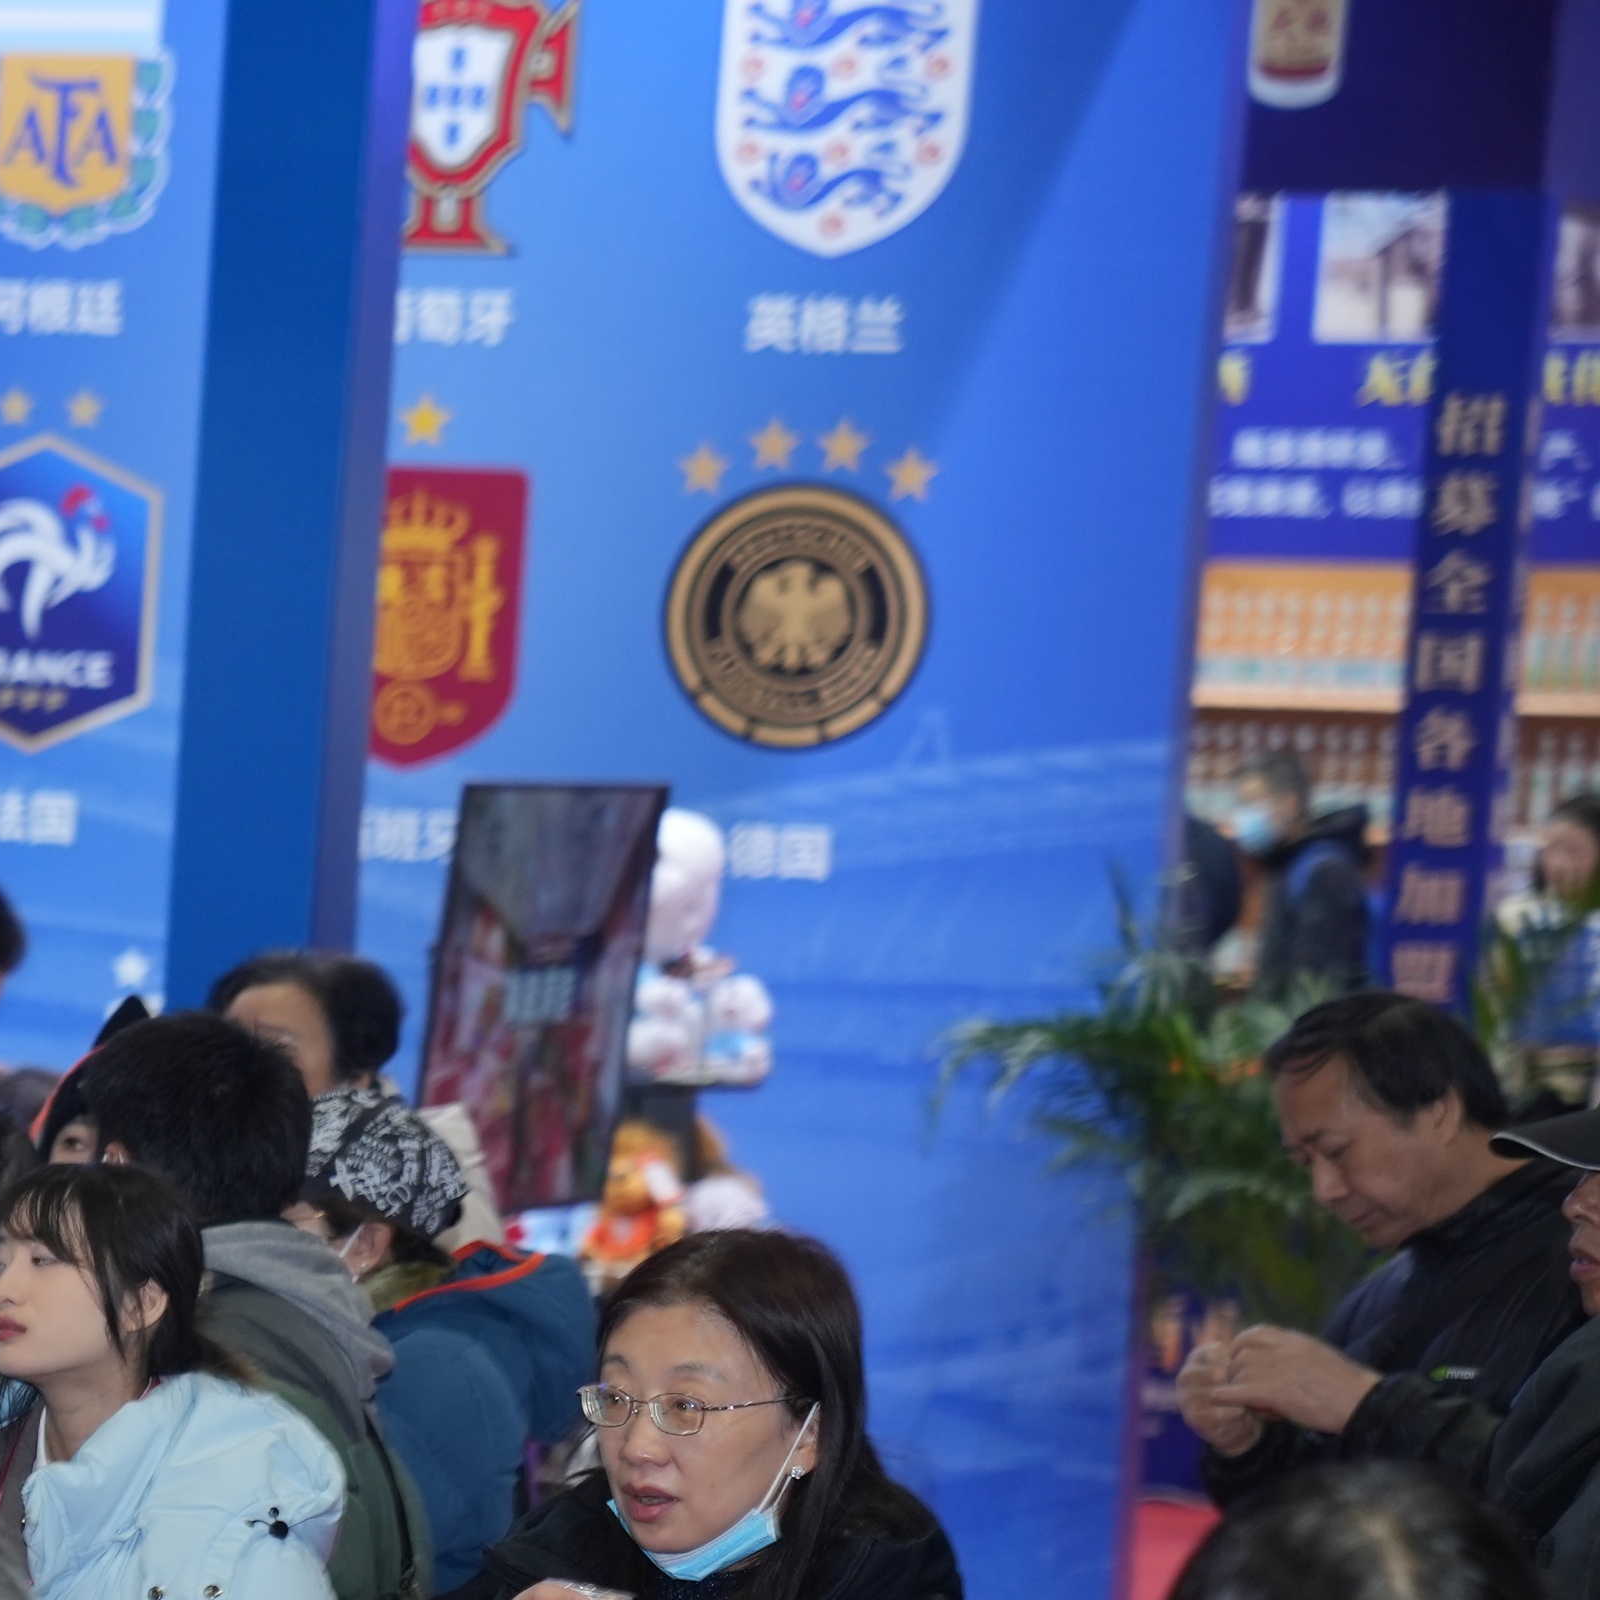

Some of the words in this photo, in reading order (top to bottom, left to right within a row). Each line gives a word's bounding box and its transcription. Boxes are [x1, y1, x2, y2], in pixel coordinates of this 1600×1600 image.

[745, 293, 904, 354] 英格兰
[1388, 393, 1507, 1002] 招募全国各地加盟
[730, 822, 833, 882] 德国
